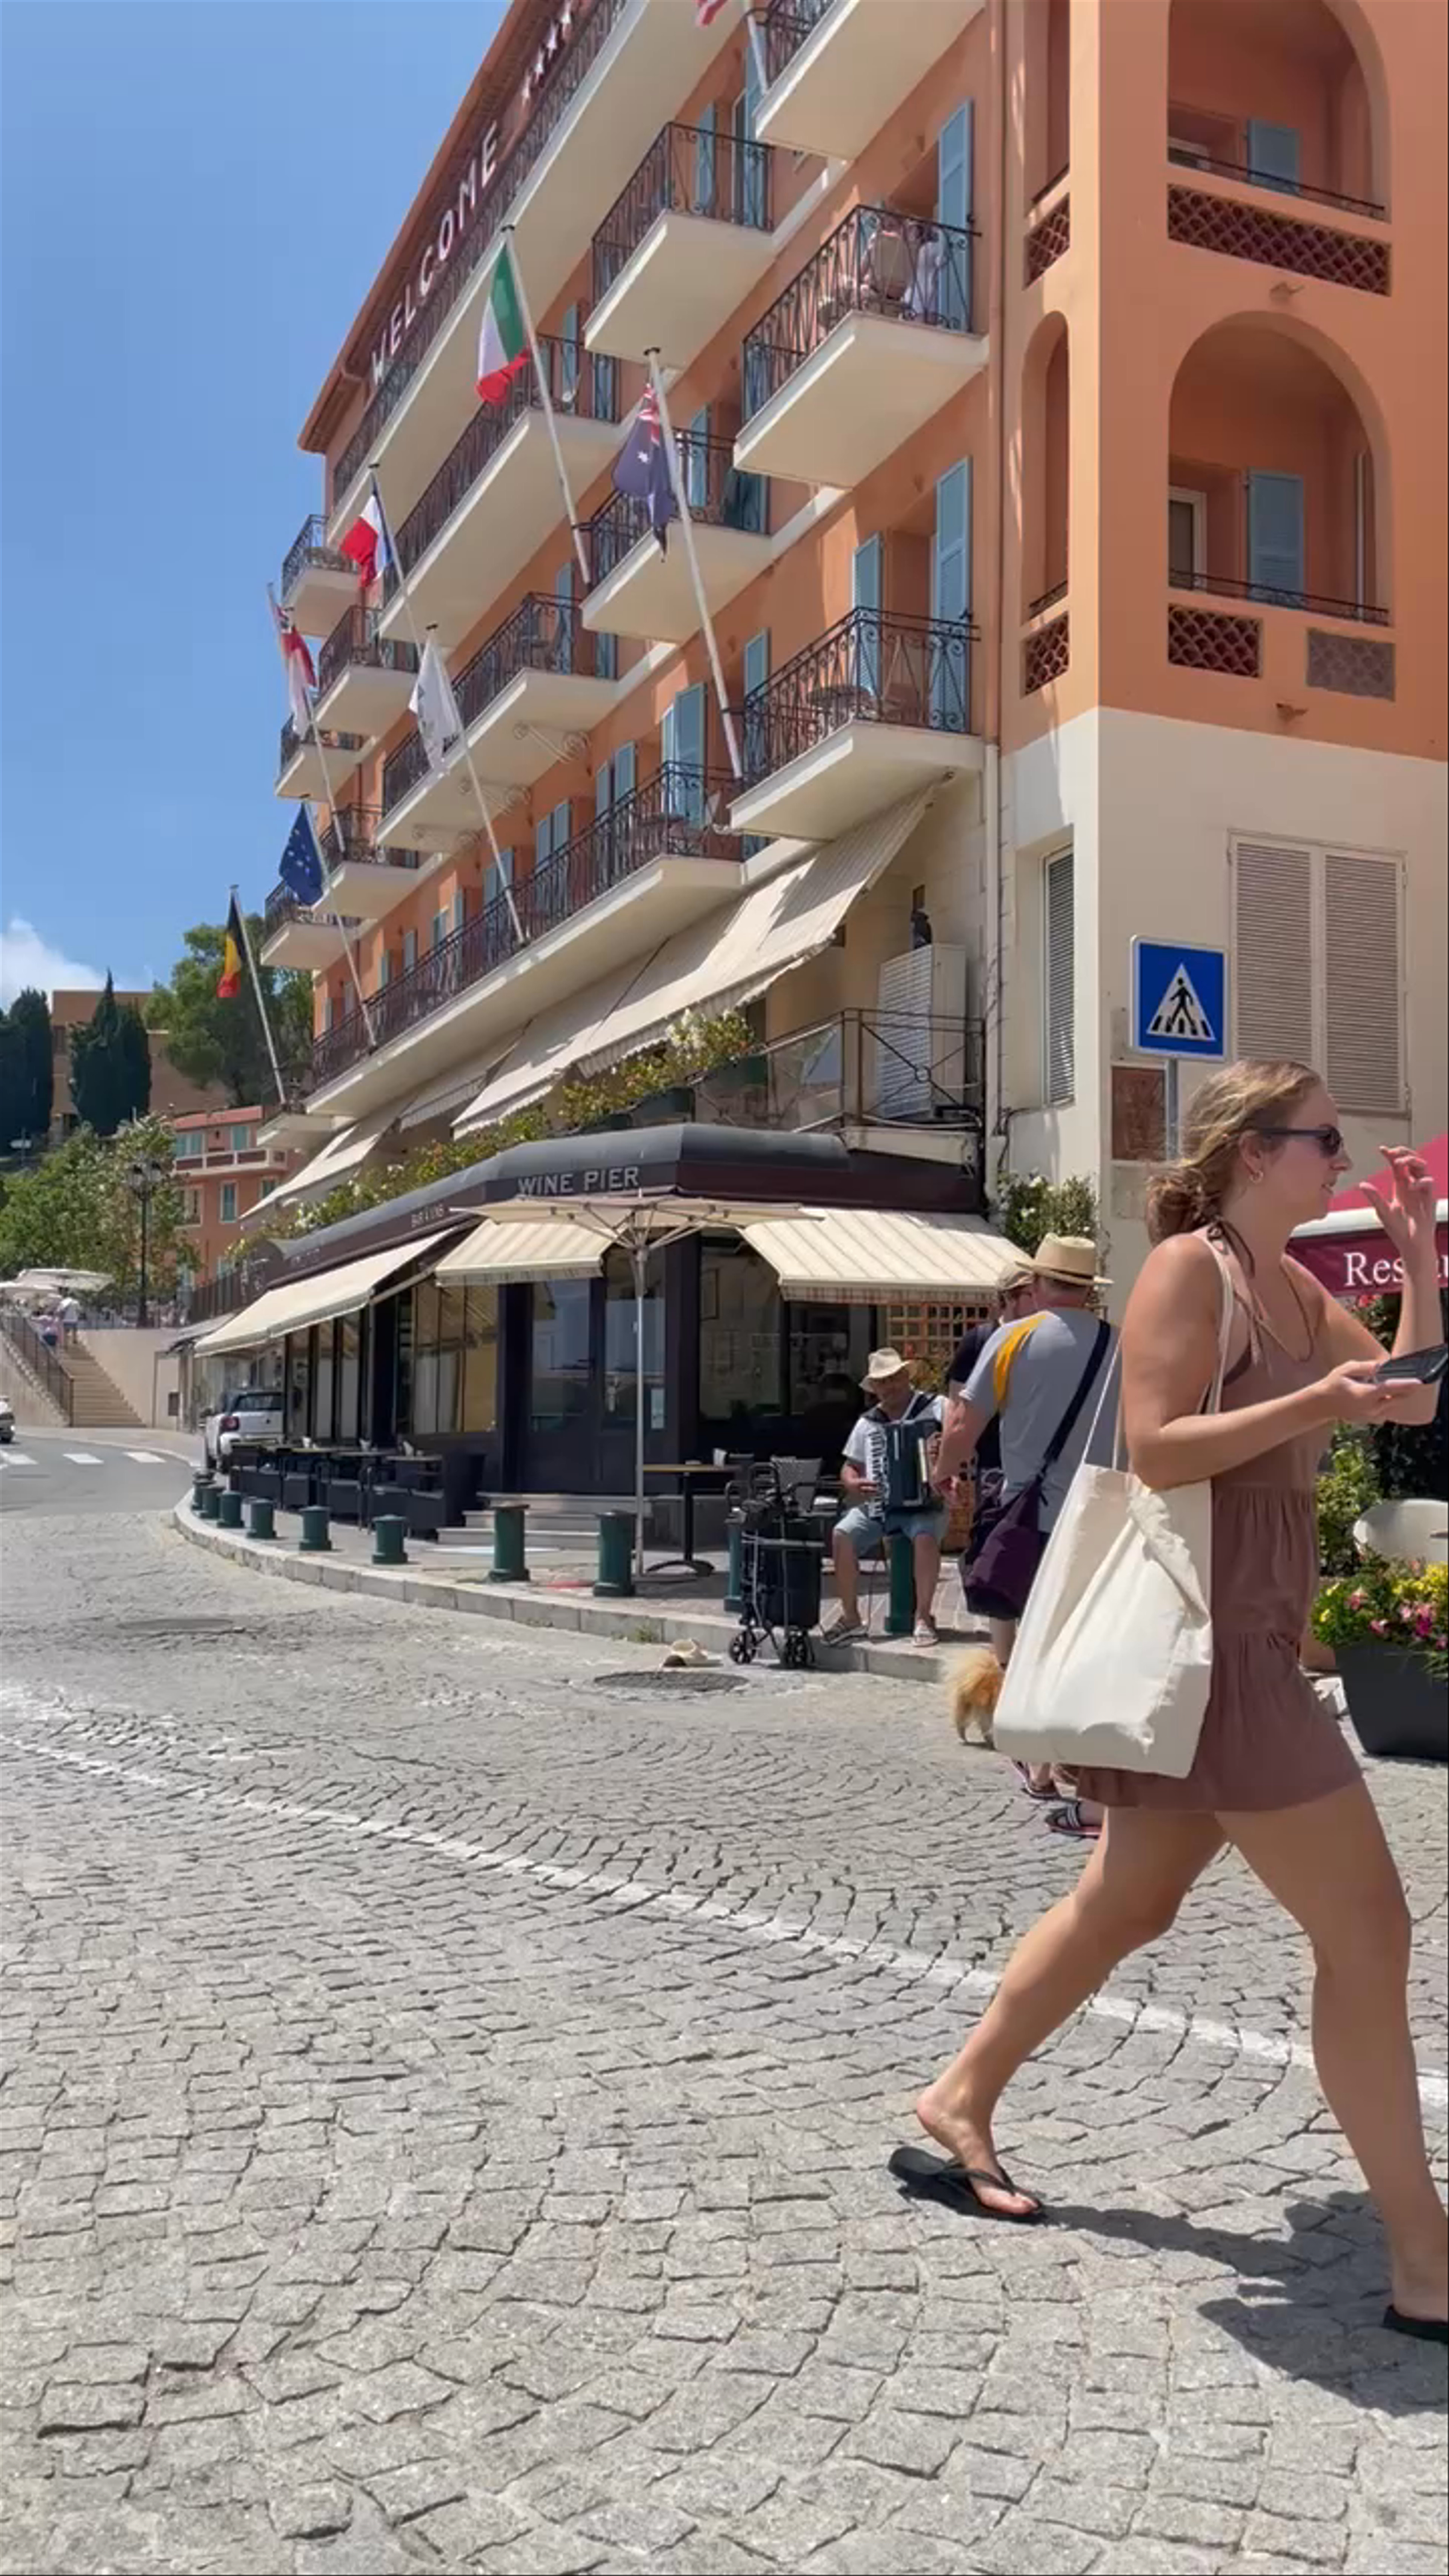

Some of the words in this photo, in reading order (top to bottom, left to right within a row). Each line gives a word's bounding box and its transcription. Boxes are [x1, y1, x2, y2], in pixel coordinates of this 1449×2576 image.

[371, 120, 498, 384] WELCOME
[518, 1173, 574, 1195] WINE
[584, 1166, 639, 1191] PIER
